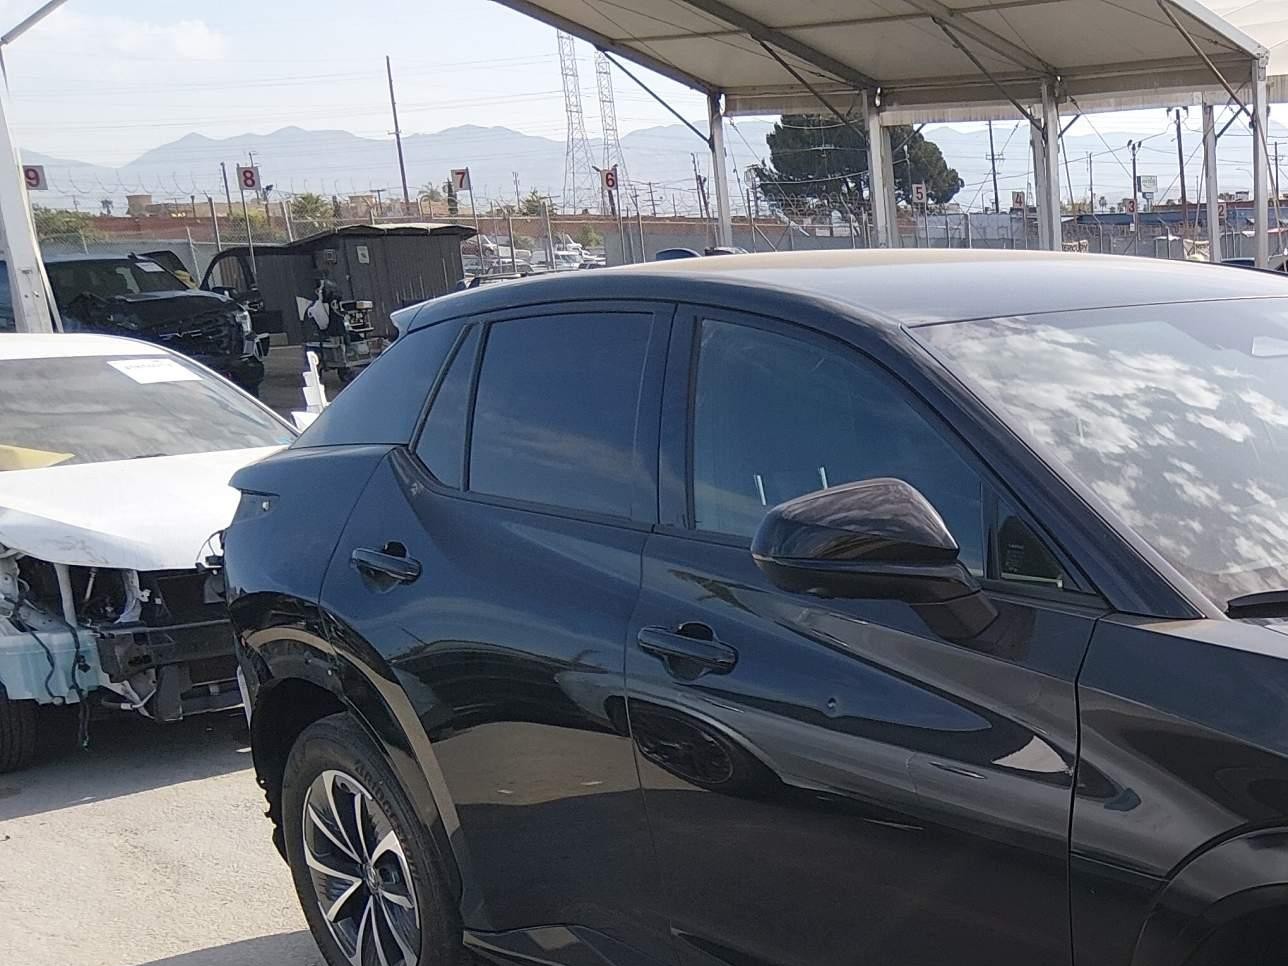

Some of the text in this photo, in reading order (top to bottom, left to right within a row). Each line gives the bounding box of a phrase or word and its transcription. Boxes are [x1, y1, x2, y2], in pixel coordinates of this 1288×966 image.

[24, 168, 40, 188] 9
[243, 169, 256, 188] 8
[455, 171, 466, 189] 7
[605, 172, 615, 188] 6
[915, 186, 924, 201] 5
[1015, 193, 1023, 207] 4
[1128, 200, 1135, 213] 3
[1218, 204, 1225, 217] 2
